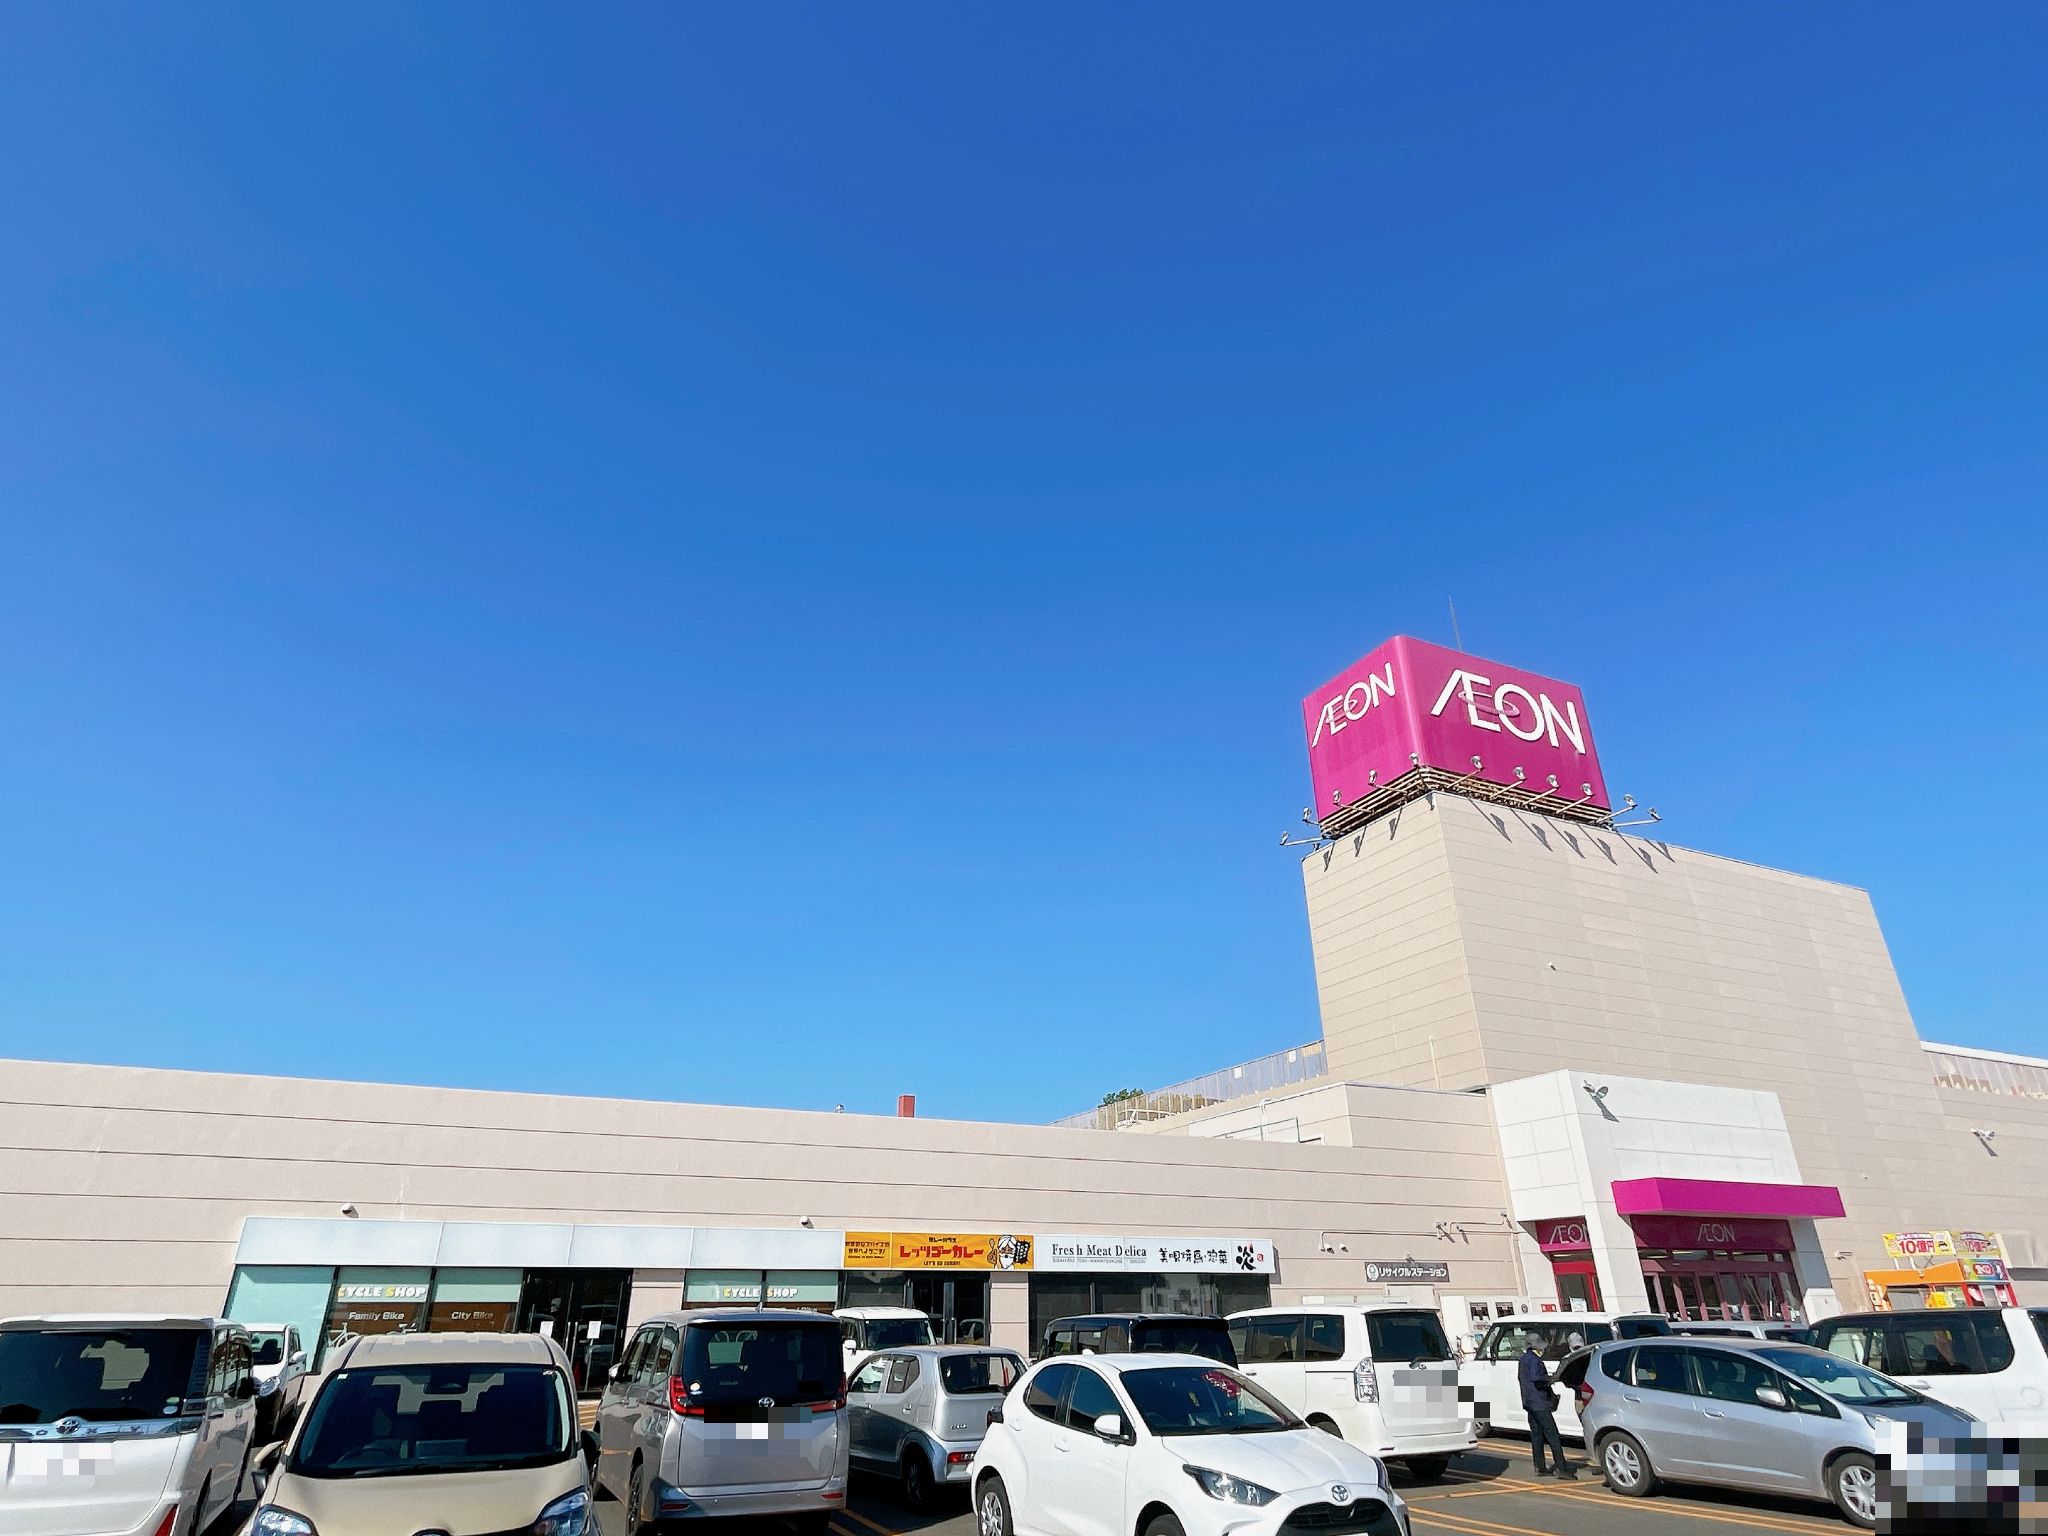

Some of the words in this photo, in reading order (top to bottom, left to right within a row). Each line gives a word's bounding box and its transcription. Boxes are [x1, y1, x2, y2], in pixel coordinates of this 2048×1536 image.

[899, 1244, 984, 1259] レッツゴーカレー
[1052, 1243, 1083, 1256] Fresh
[1086, 1244, 1112, 1257] Meat
[1115, 1245, 1147, 1257] Delica
[1899, 1239, 1936, 1255] 10億円
[1379, 1266, 1447, 1278] リサイクルステーション
[337, 1285, 382, 1298] CYCLE
[384, 1285, 427, 1298] SHOP
[723, 1287, 761, 1299] CYCLE
[766, 1287, 799, 1299] SHOP
[348, 1311, 380, 1321] Family
[382, 1311, 405, 1321] Bike
[451, 1311, 471, 1321] City
[472, 1311, 494, 1320] Bike
